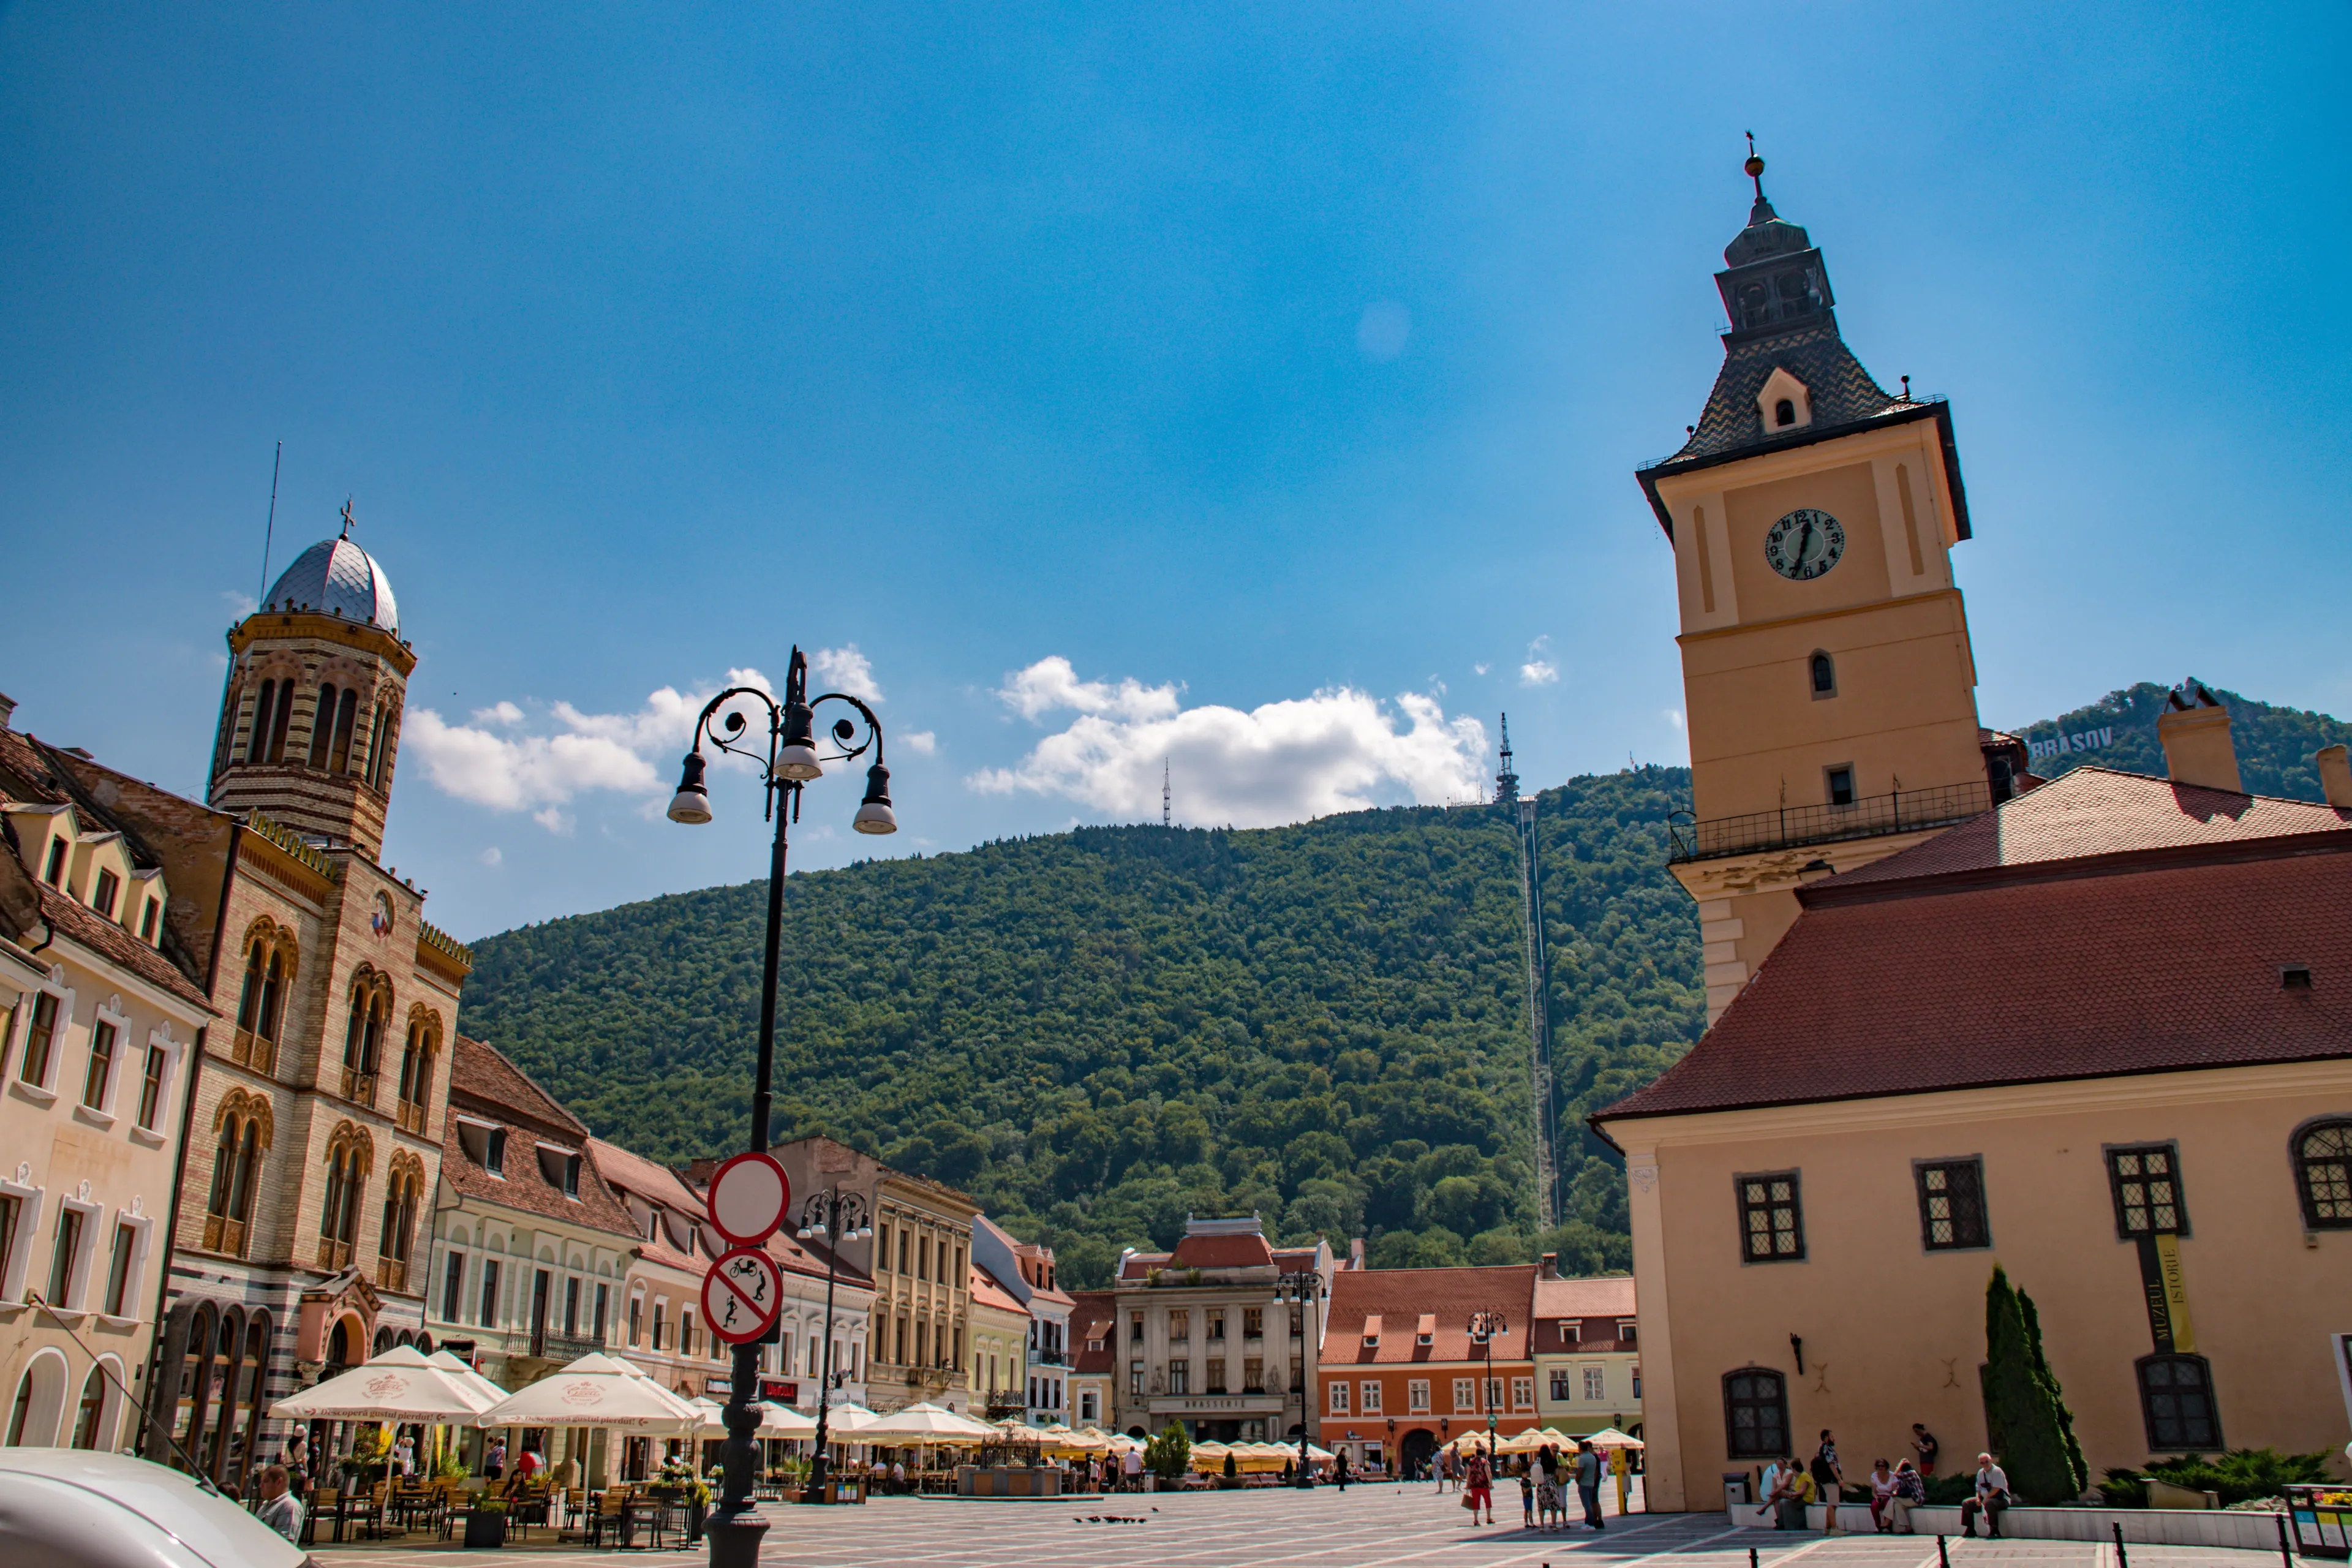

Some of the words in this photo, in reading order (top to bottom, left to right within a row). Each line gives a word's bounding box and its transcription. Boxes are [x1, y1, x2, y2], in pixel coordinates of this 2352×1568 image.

[1793, 511, 1809, 524] 12
[1813, 513, 1820, 523] 1
[1781, 519, 1792, 530] 11
[1825, 519, 1834, 530] 2
[1771, 531, 1782, 543] 10
[1831, 532, 1840, 544] 3
[1770, 546, 1778, 556] 9
[1828, 547, 1838, 559] 4
[1776, 559, 1784, 570] 8
[1819, 560, 1828, 571] 5
[1789, 565, 1800, 577] 7
[1804, 566, 1812, 578] 6
[2163, 1248, 2184, 1303] ISTORIE
[2149, 1279, 2169, 1340] MUZEUL
[370, 1409, 397, 1419] gustul
